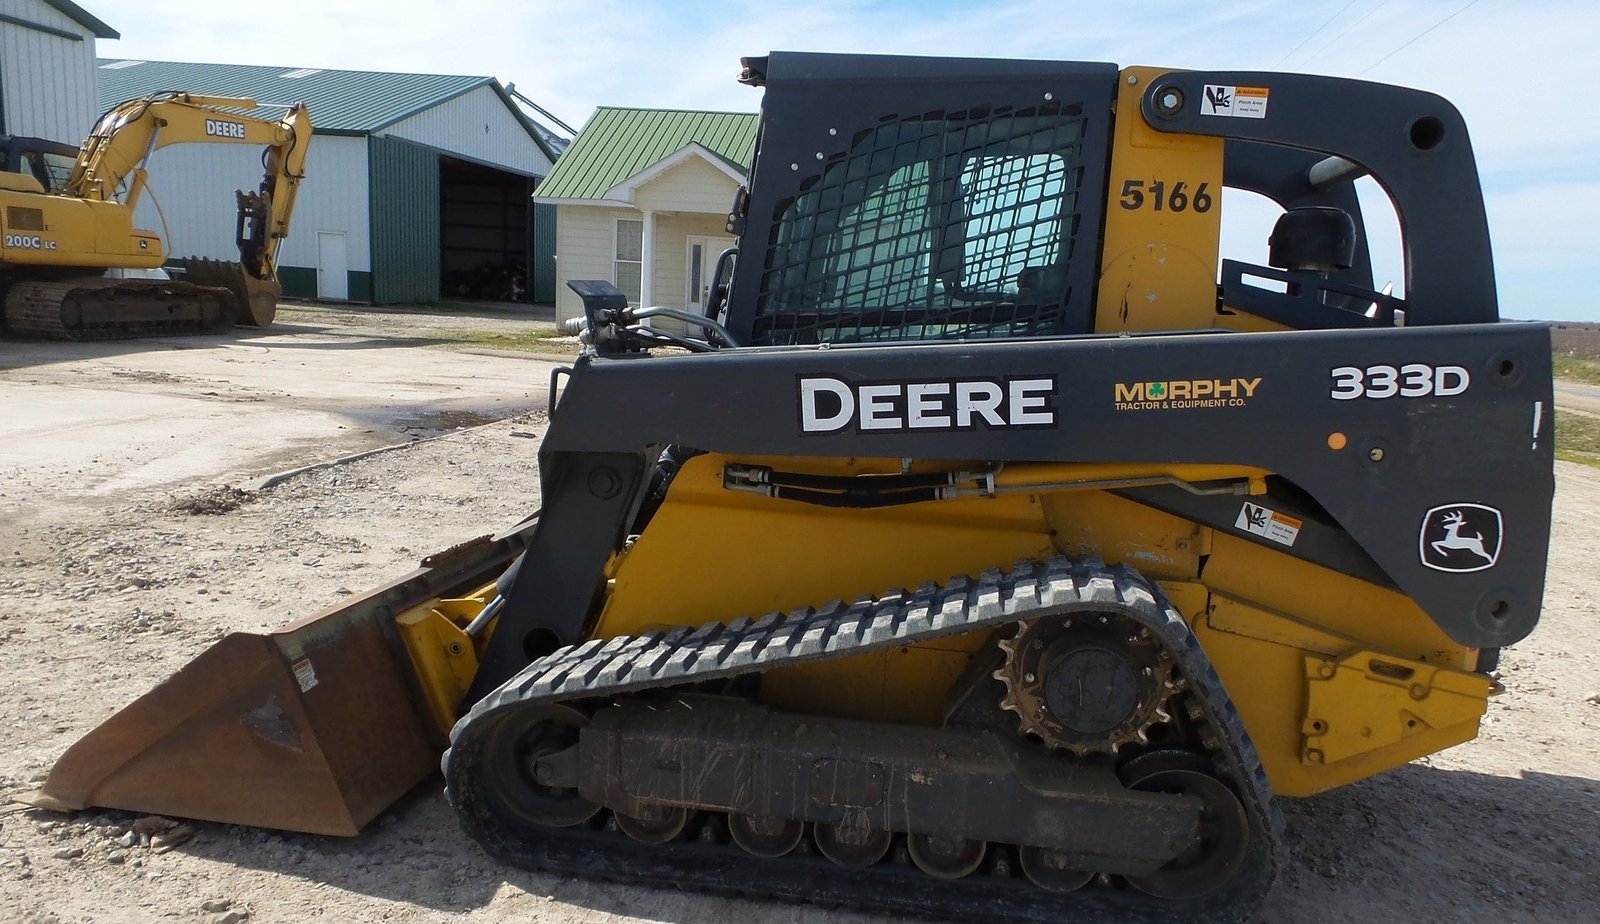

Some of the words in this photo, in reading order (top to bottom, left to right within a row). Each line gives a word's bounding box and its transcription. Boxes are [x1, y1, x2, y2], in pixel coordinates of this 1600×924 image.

[206, 120, 245, 138] DEERE
[1119, 179, 1212, 214] 5166
[6, 234, 40, 248] 200C
[44, 240, 56, 249] LC
[1114, 377, 1263, 402] MURPHY
[1330, 363, 1471, 400] 333D
[800, 377, 1054, 432] DEERE
[1115, 401, 1160, 411] TRACTOR
[1162, 400, 1169, 409] &
[1171, 399, 1227, 409] EQUIPMENT
[1228, 398, 1246, 407] CO.
